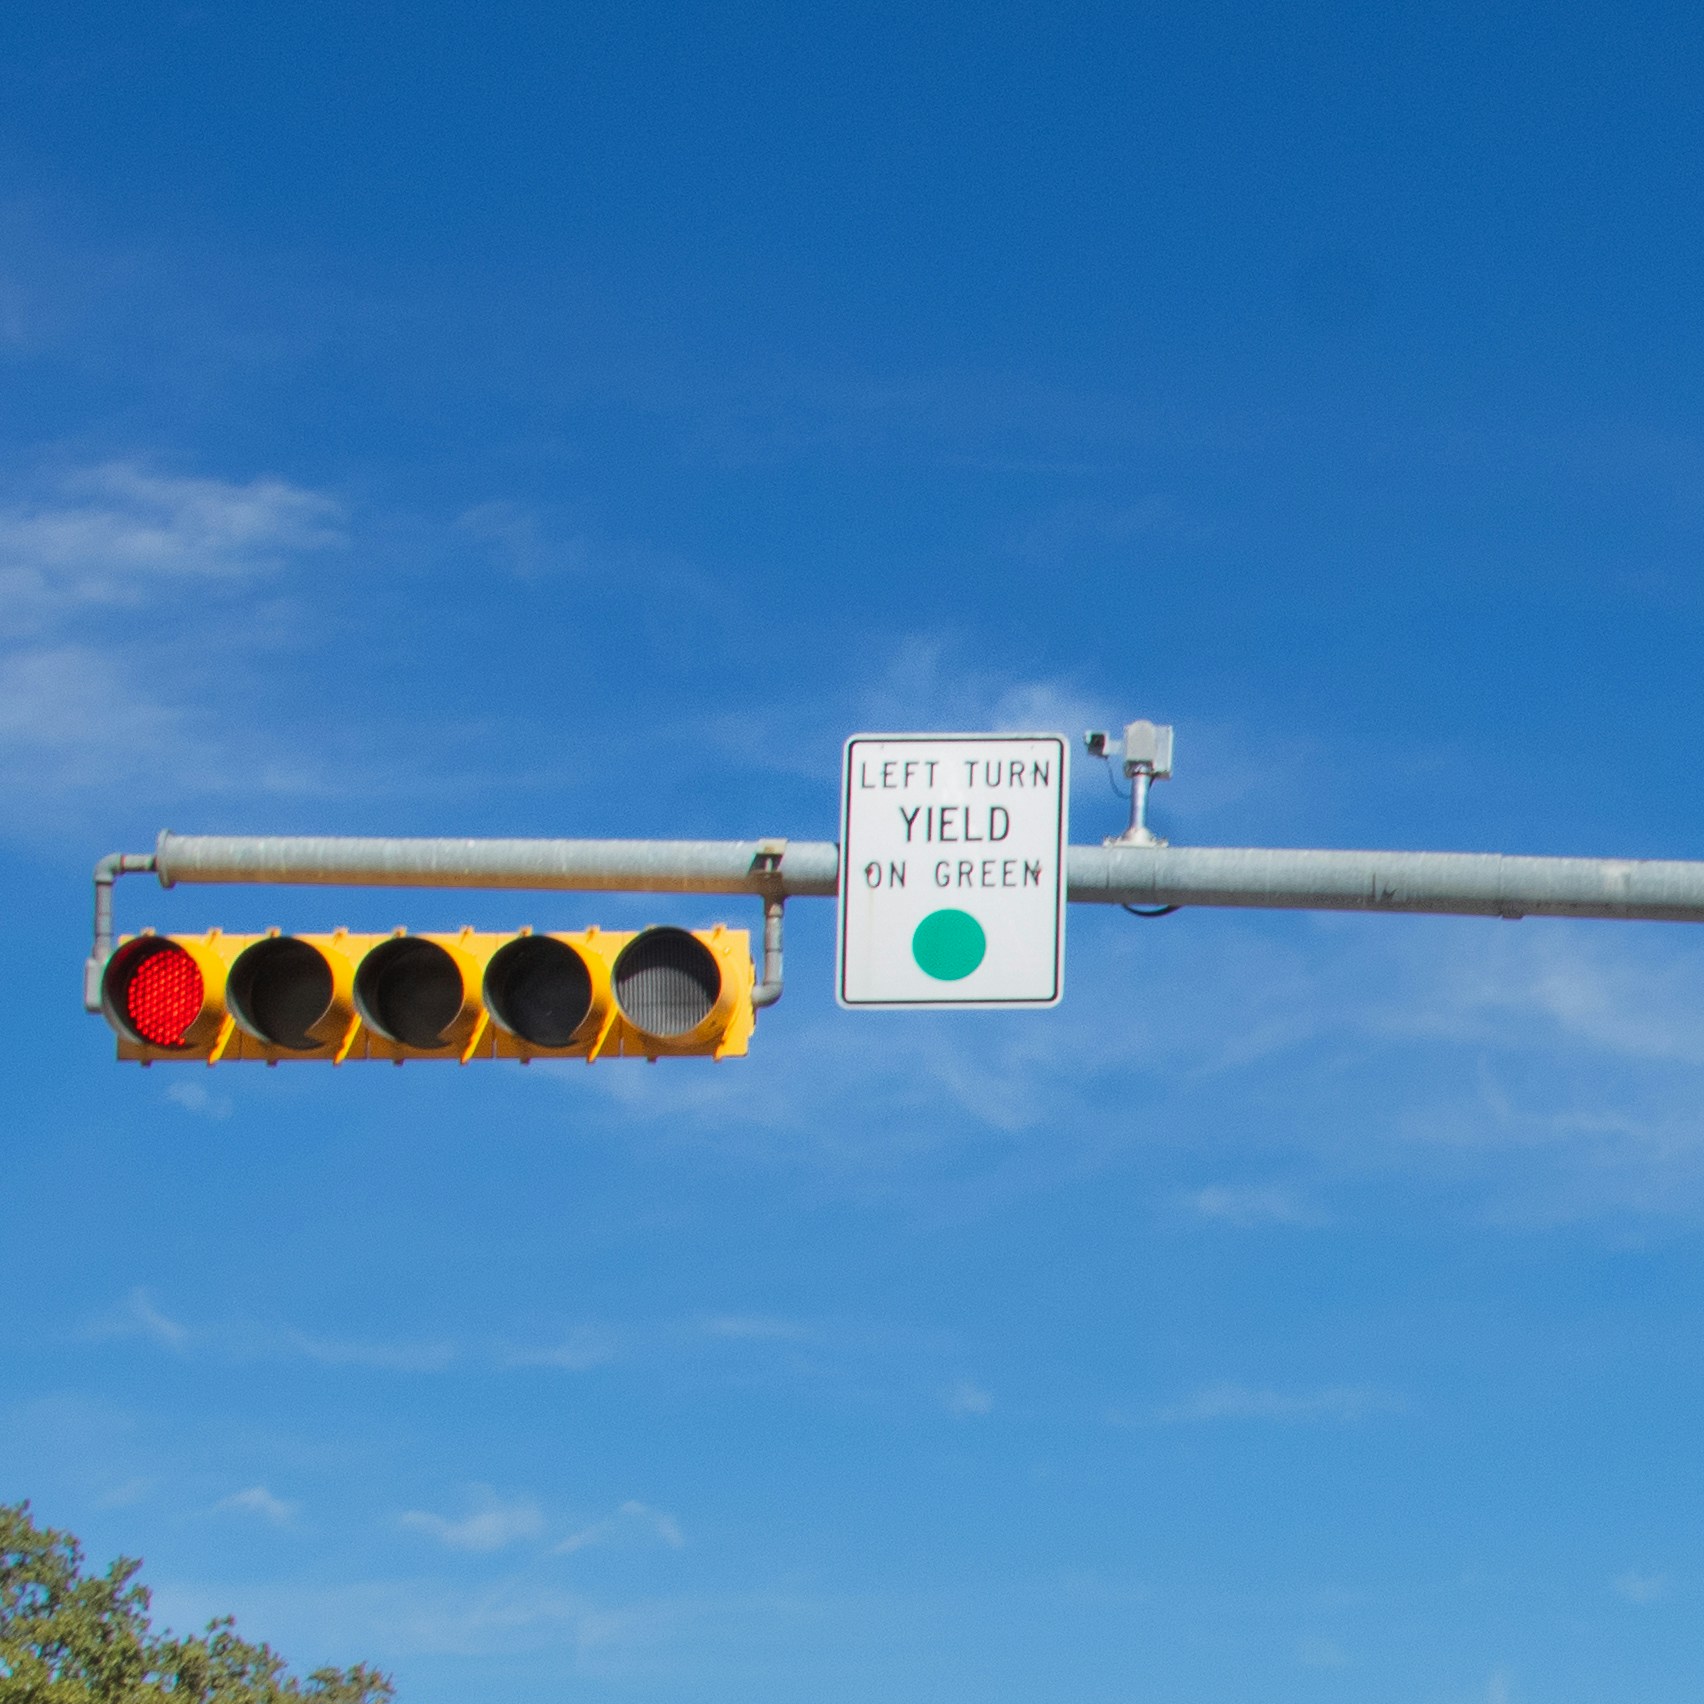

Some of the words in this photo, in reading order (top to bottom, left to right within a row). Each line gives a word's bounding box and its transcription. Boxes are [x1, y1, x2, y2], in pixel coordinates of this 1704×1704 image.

[861, 761, 939, 788] LEFT
[965, 760, 1050, 788] TURN
[900, 805, 1011, 842] YIELD
[865, 860, 906, 889] ON
[935, 859, 1041, 888] GREEN
